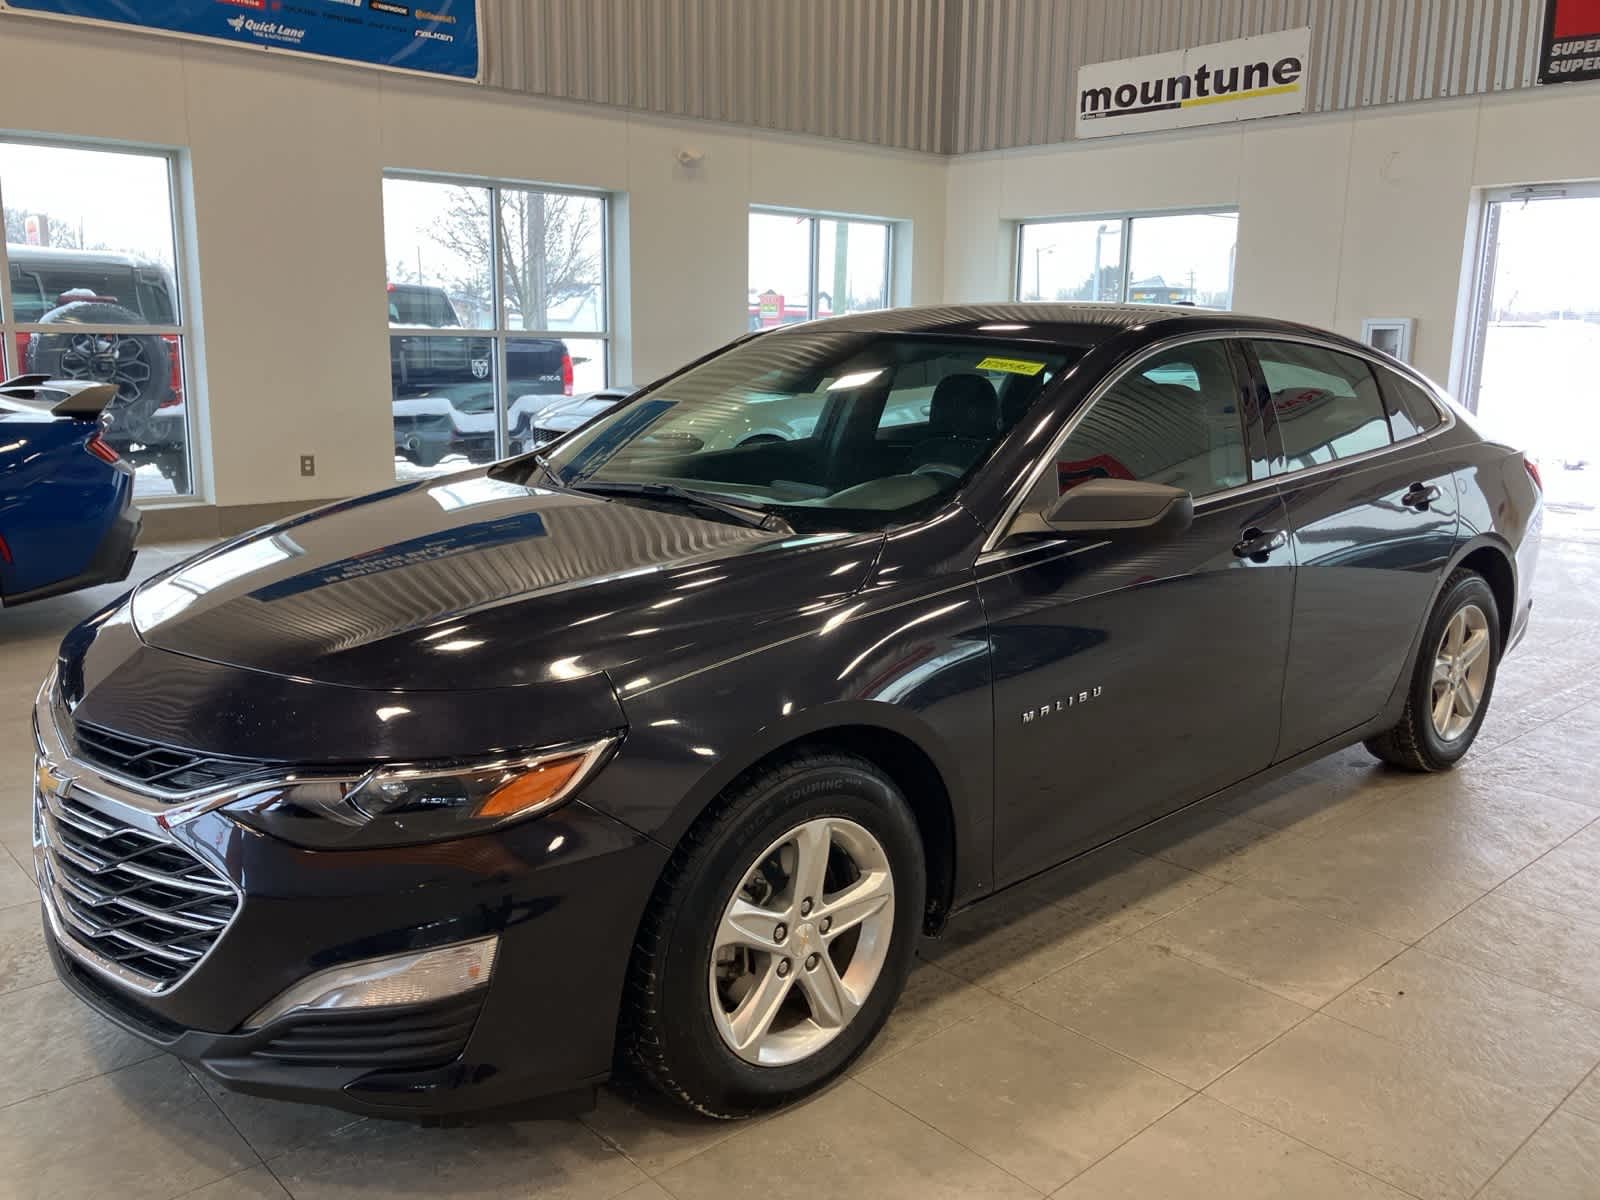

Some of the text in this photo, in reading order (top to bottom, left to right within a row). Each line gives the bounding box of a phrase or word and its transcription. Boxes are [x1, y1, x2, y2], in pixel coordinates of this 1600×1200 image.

[245, 20, 304, 38] Quick Lane
[1081, 57, 1302, 113] mountune
[1023, 686, 1102, 723] MALIBU
